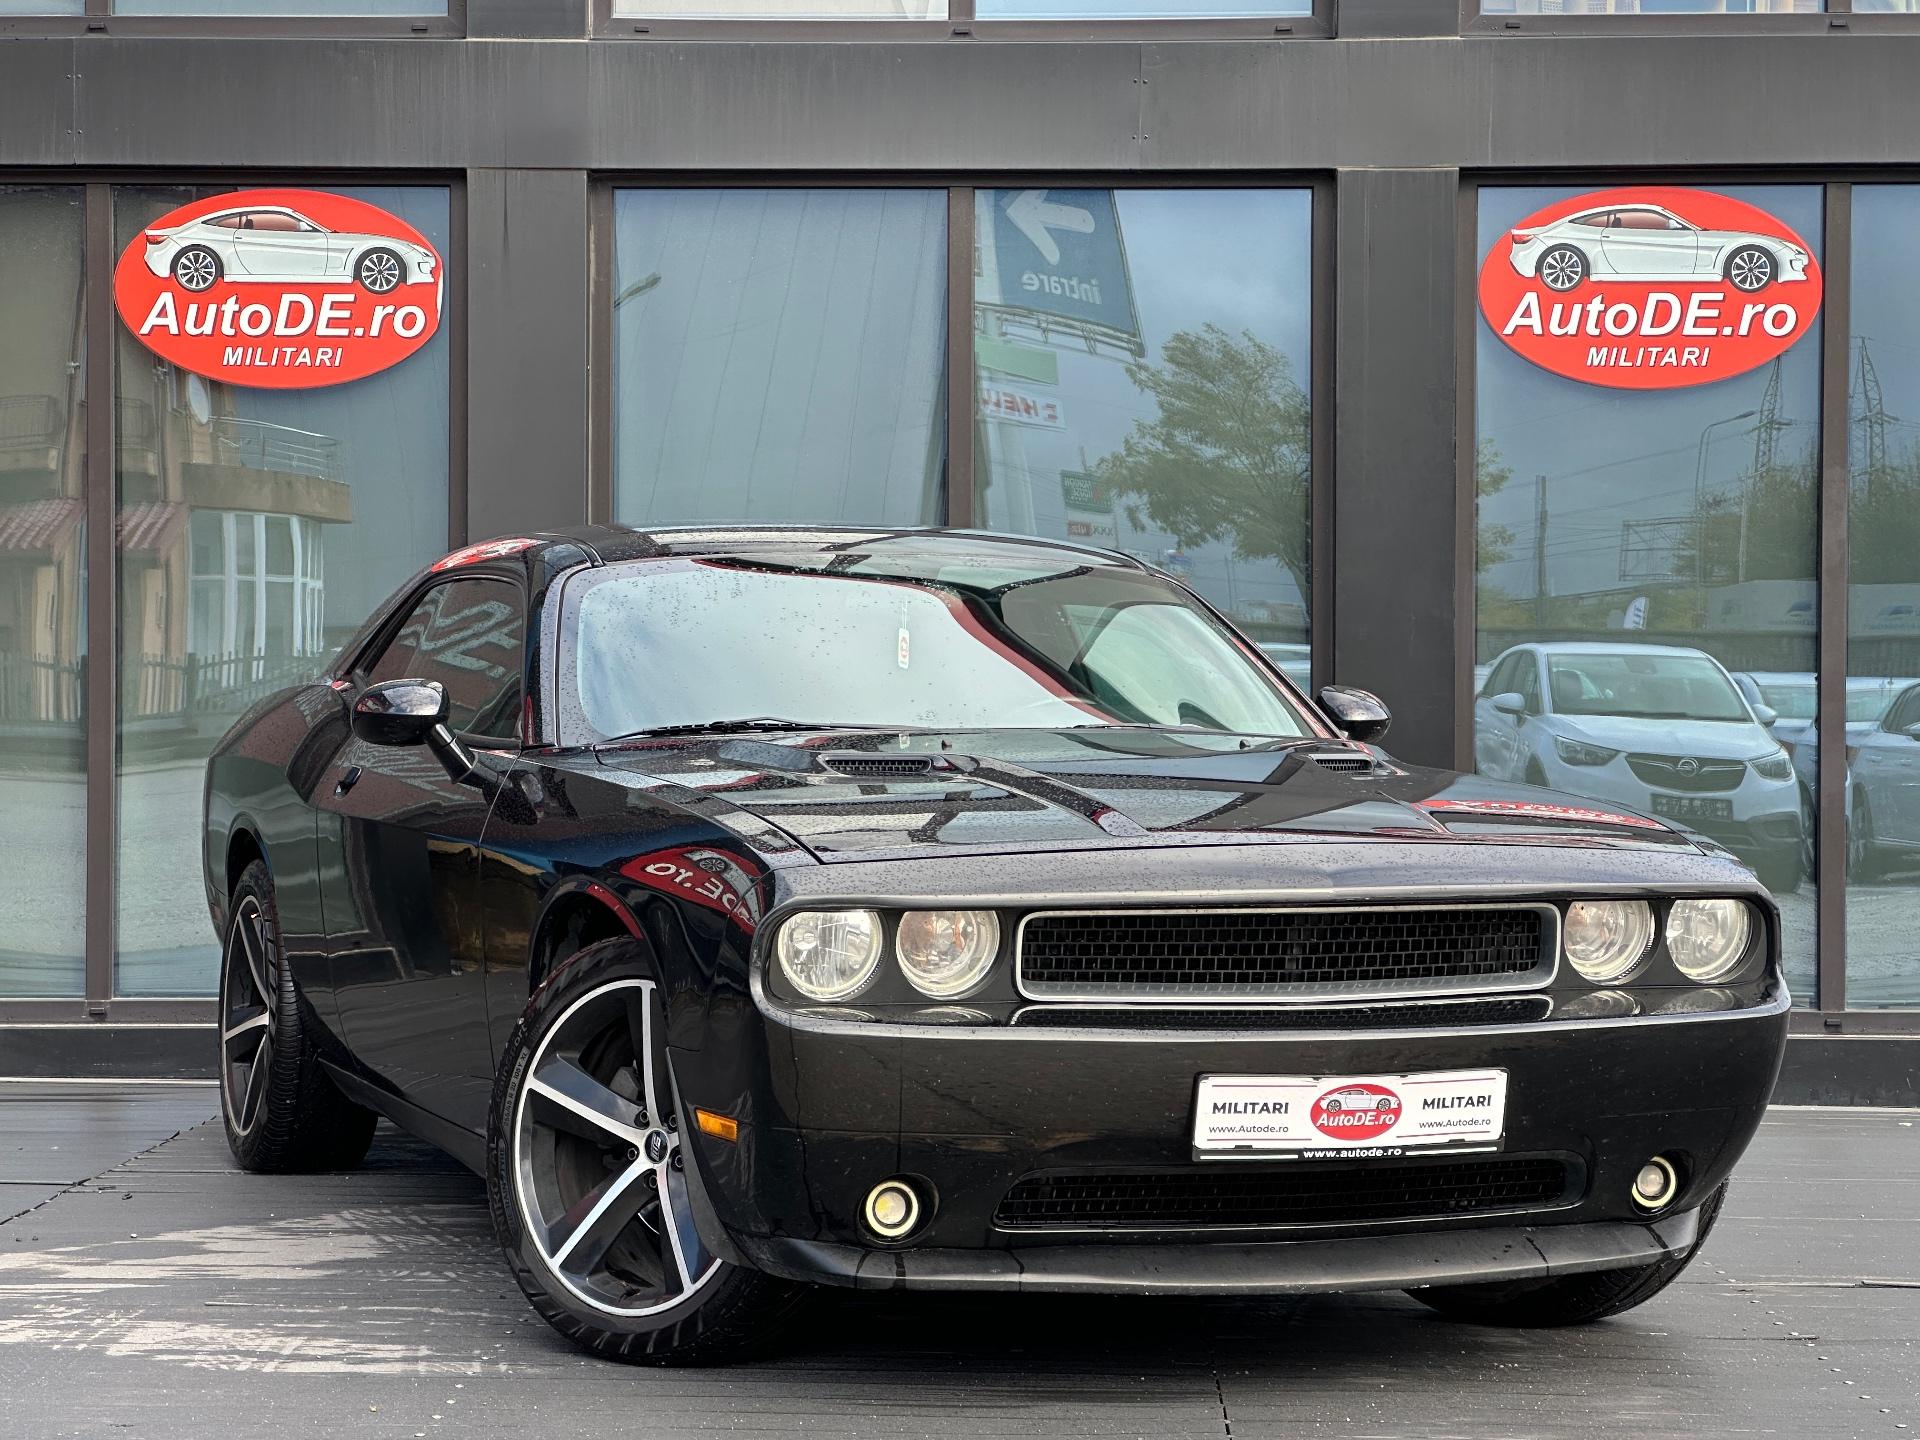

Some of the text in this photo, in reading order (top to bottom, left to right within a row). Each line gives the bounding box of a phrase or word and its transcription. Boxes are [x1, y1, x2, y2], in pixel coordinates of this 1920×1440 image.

[138, 291, 427, 338] AutoDE.ro
[1502, 291, 1798, 338] AutoDE.ro
[222, 346, 343, 367] MILITARI
[1586, 346, 1711, 367] MILITARI
[1212, 1102, 1289, 1114] MILITARI
[1422, 1095, 1492, 1110] MILITARI
[1316, 1111, 1395, 1127] AutoDE.ro
[1419, 1117, 1491, 1129] www.Autode.ro
[1208, 1125, 1289, 1133] www.Autode.ro
[1303, 1147, 1402, 1158] www.autode.ro
